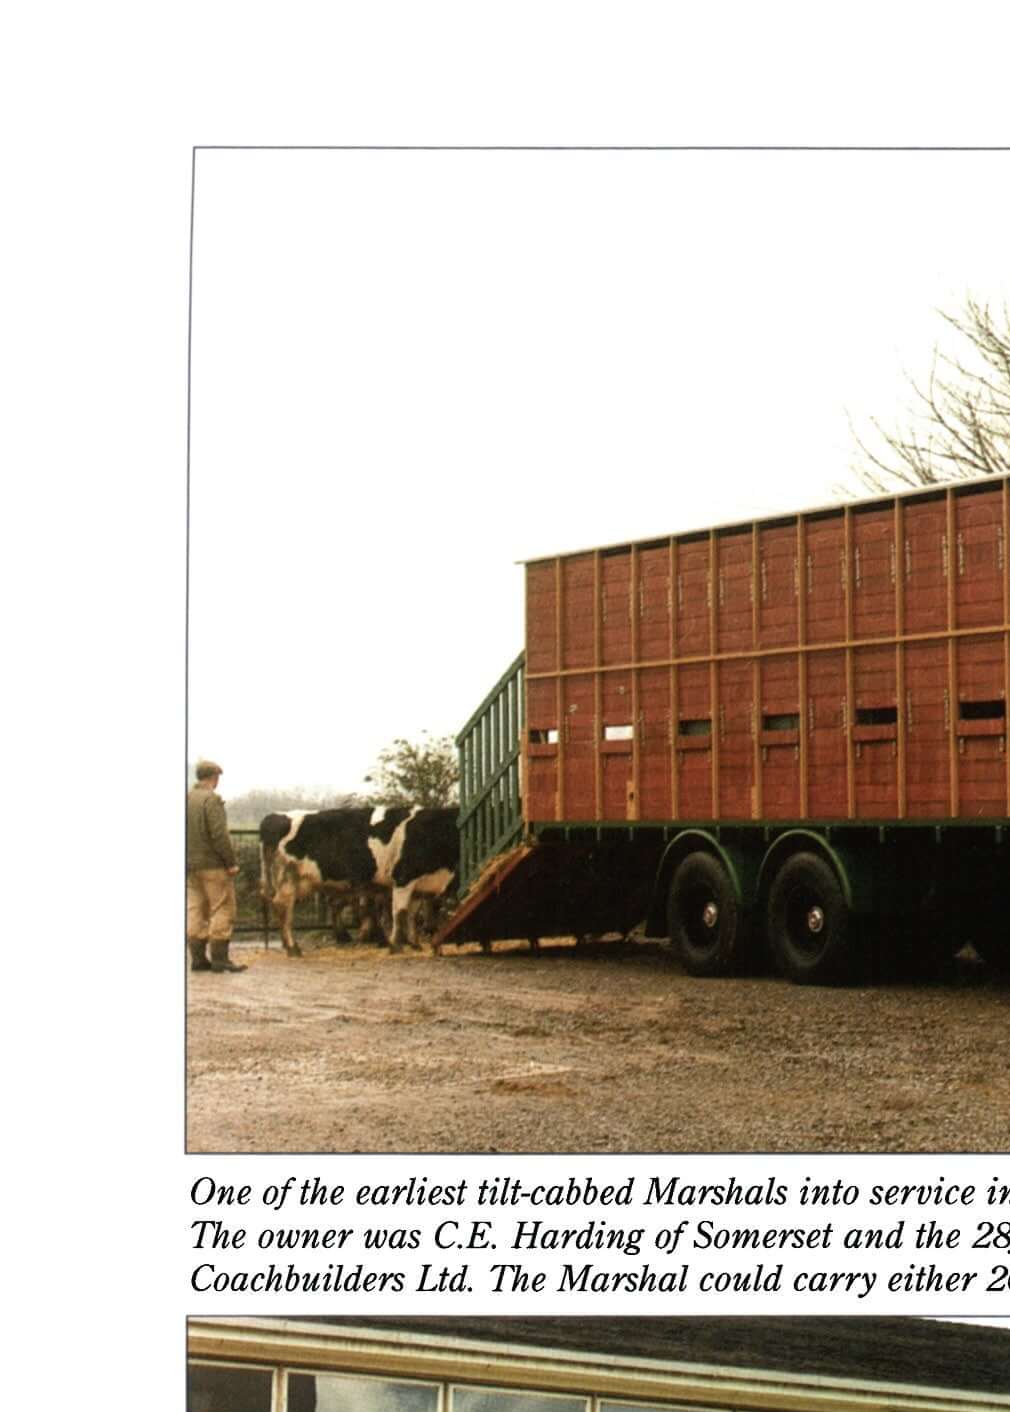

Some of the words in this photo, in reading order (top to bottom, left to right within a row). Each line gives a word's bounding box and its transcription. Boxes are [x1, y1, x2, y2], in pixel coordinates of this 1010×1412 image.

[190, 1176, 252, 1206] One
[262, 1176, 297, 1211] of
[299, 1176, 345, 1206] the
[355, 1176, 468, 1206] earliest
[477, 1176, 635, 1206] tilt-cabbed
[642, 1176, 788, 1206] Marshals
[799, 1176, 860, 1206] into
[869, 1176, 976, 1206] service
[190, 1220, 247, 1250] The
[257, 1228, 354, 1249] owner
[363, 1228, 422, 1250] was
[434, 1220, 497, 1250] C.E.
[510, 1220, 646, 1256] Harding
[654, 1220, 690, 1255] of
[693, 1220, 834, 1250] Somerset
[843, 1220, 905, 1249] and
[915, 1220, 961, 1249] the
[190, 1263, 406, 1293] Coachbuilders
[415, 1264, 473, 1293] Ltd.
[489, 1264, 547, 1293] The
[556, 1263, 689, 1293] Marshal
[699, 1263, 784, 1292] could
[793, 1272, 877, 1299] carry
[887, 1263, 978, 1293] either
